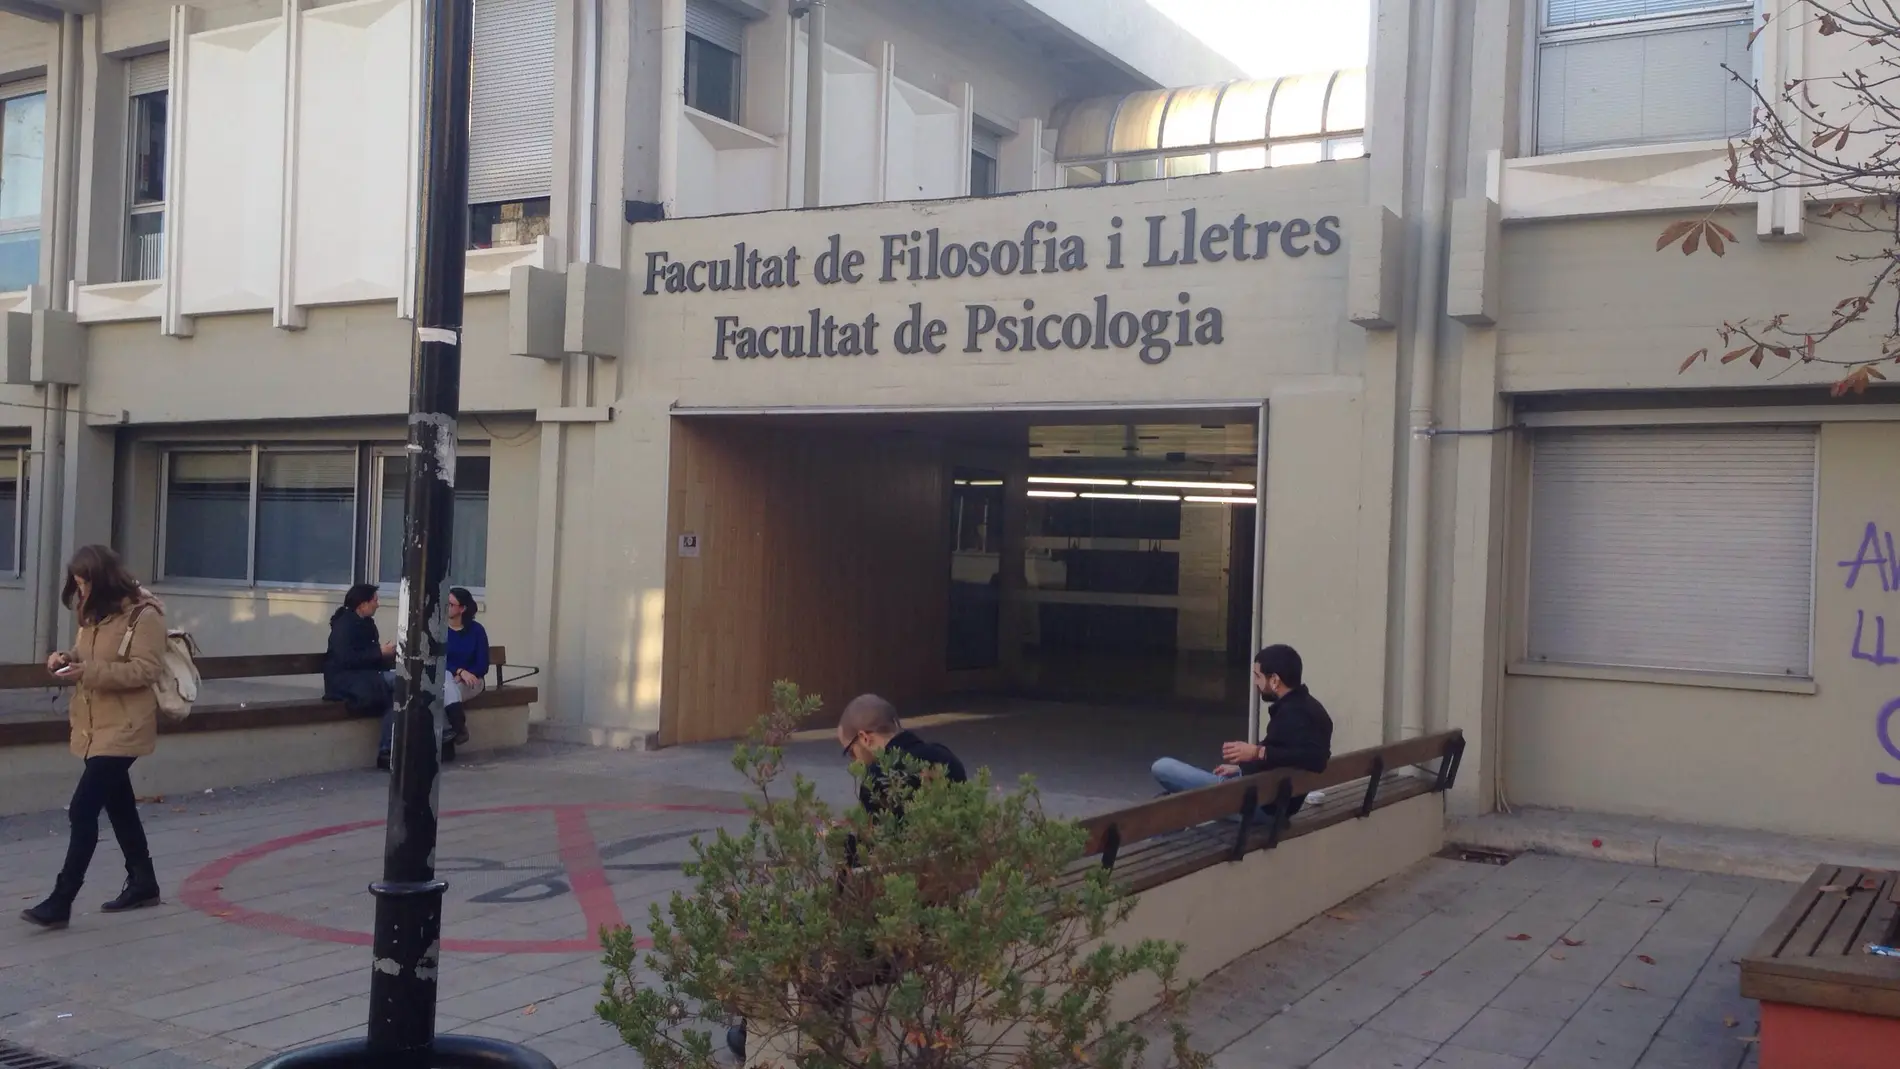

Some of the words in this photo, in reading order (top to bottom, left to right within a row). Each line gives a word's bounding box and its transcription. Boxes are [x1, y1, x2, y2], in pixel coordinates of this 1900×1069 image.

[642, 241, 801, 296] Facultat
[813, 233, 865, 286] de
[878, 220, 1089, 283] Filosofia
[1105, 216, 1125, 270] i
[1142, 207, 1341, 268] Lletres
[711, 307, 880, 361] Facultat
[893, 301, 948, 355] de
[962, 291, 1225, 365] Psicologia
